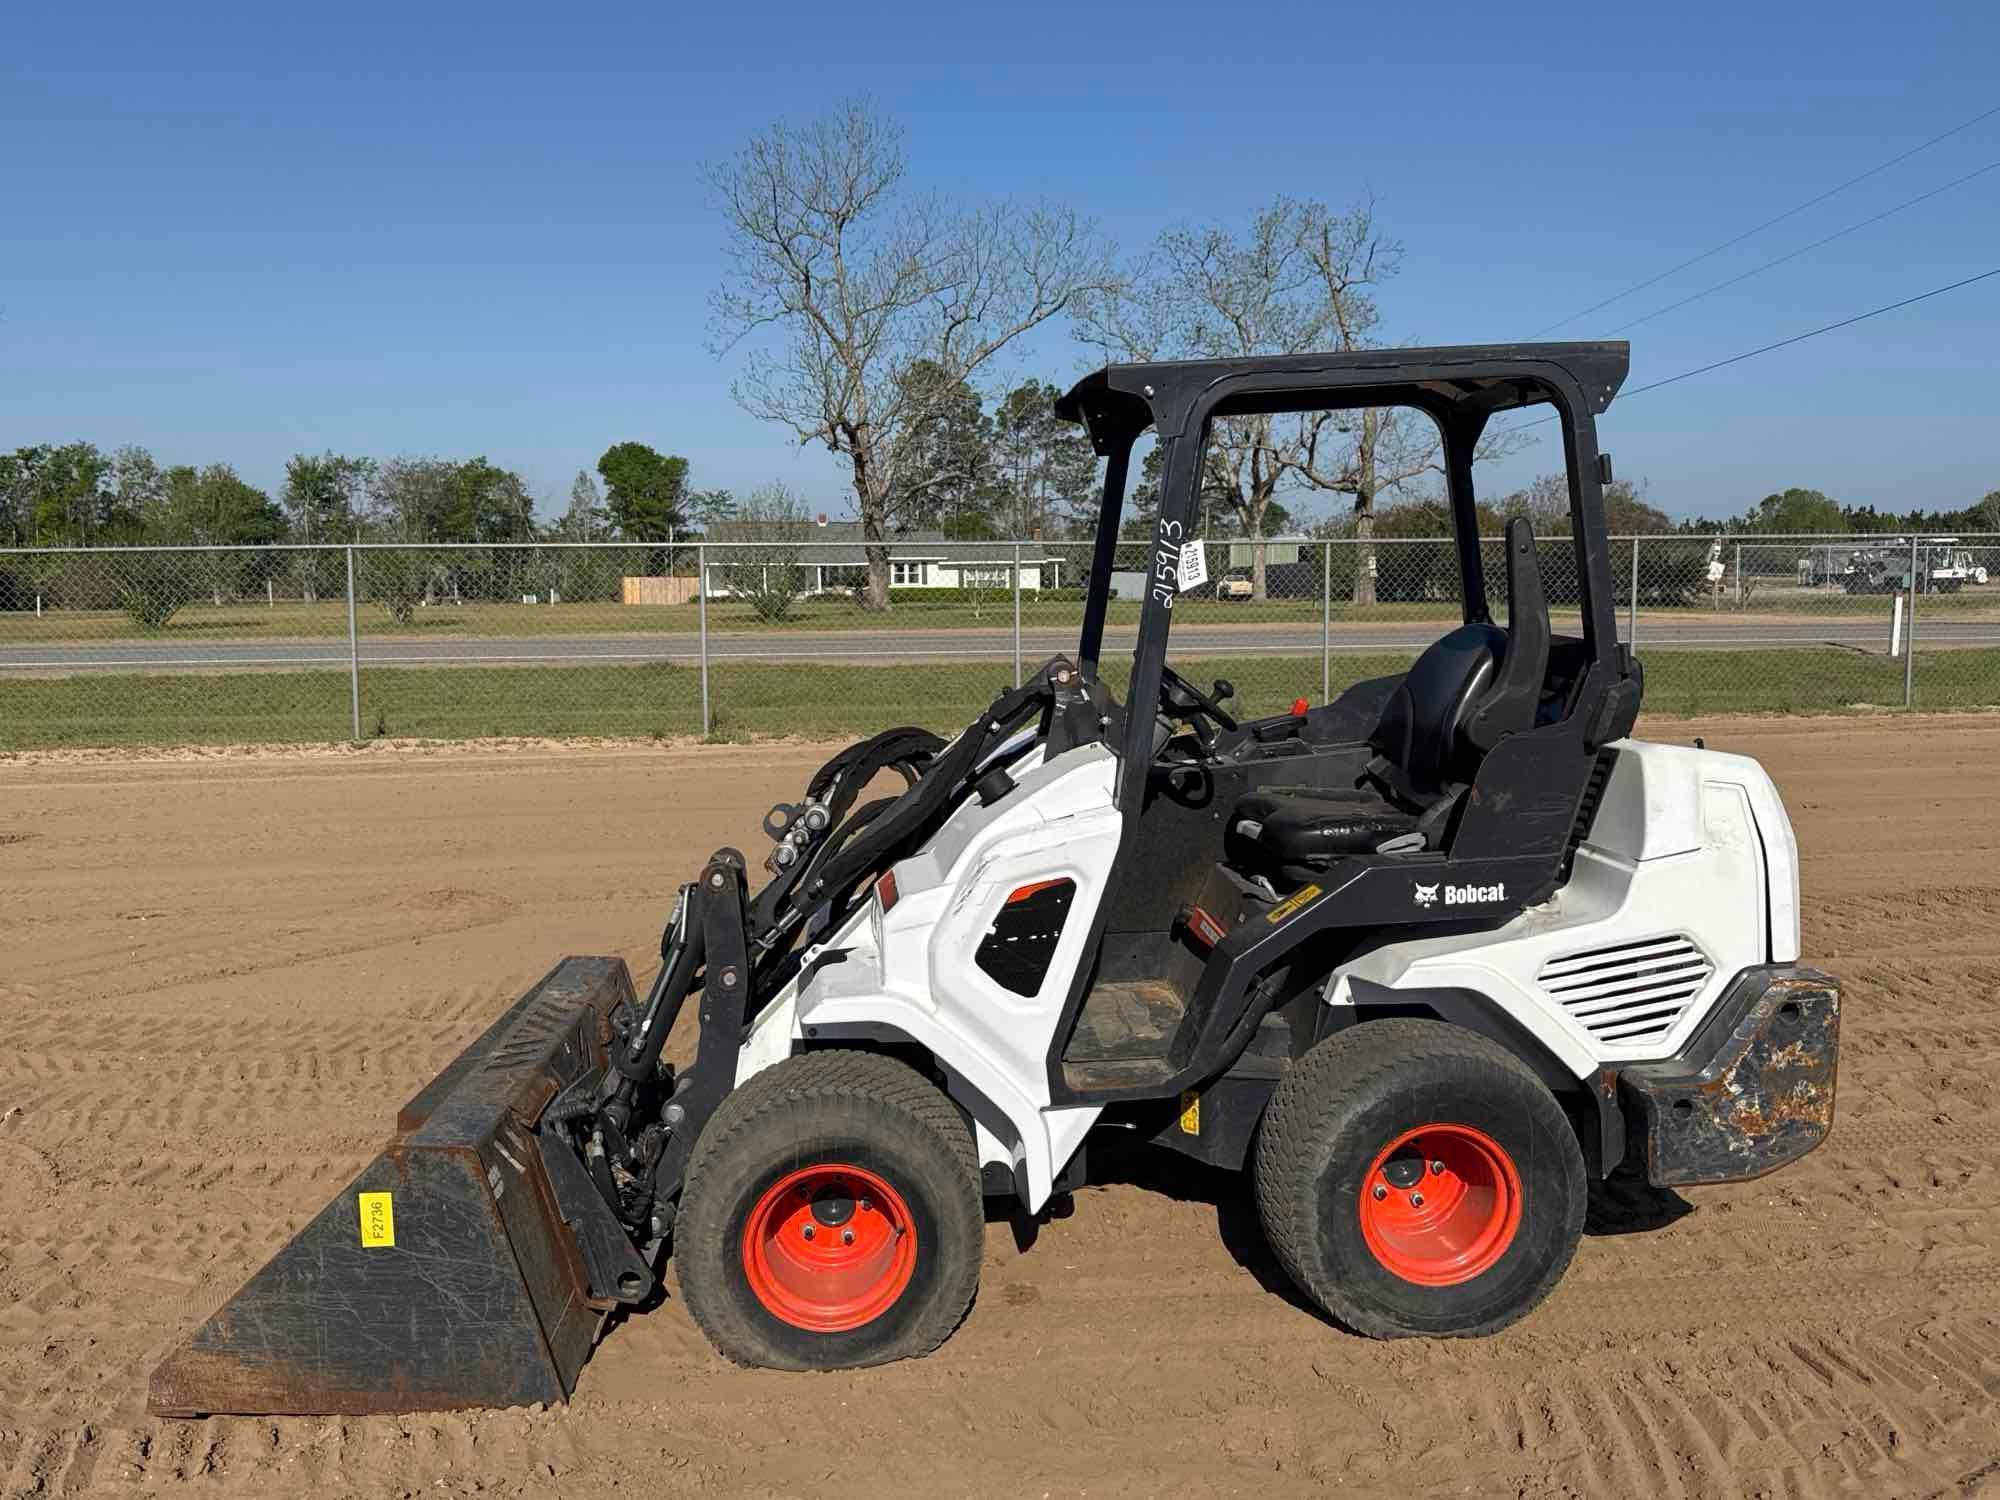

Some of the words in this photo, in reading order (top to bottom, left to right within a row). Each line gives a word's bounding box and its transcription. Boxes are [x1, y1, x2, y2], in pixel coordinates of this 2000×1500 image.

[1153, 518, 1183, 609] 215913
[1184, 548, 1201, 581] 215913
[1444, 882, 1505, 905] Bobcat
[371, 1201, 384, 1239] F2736
